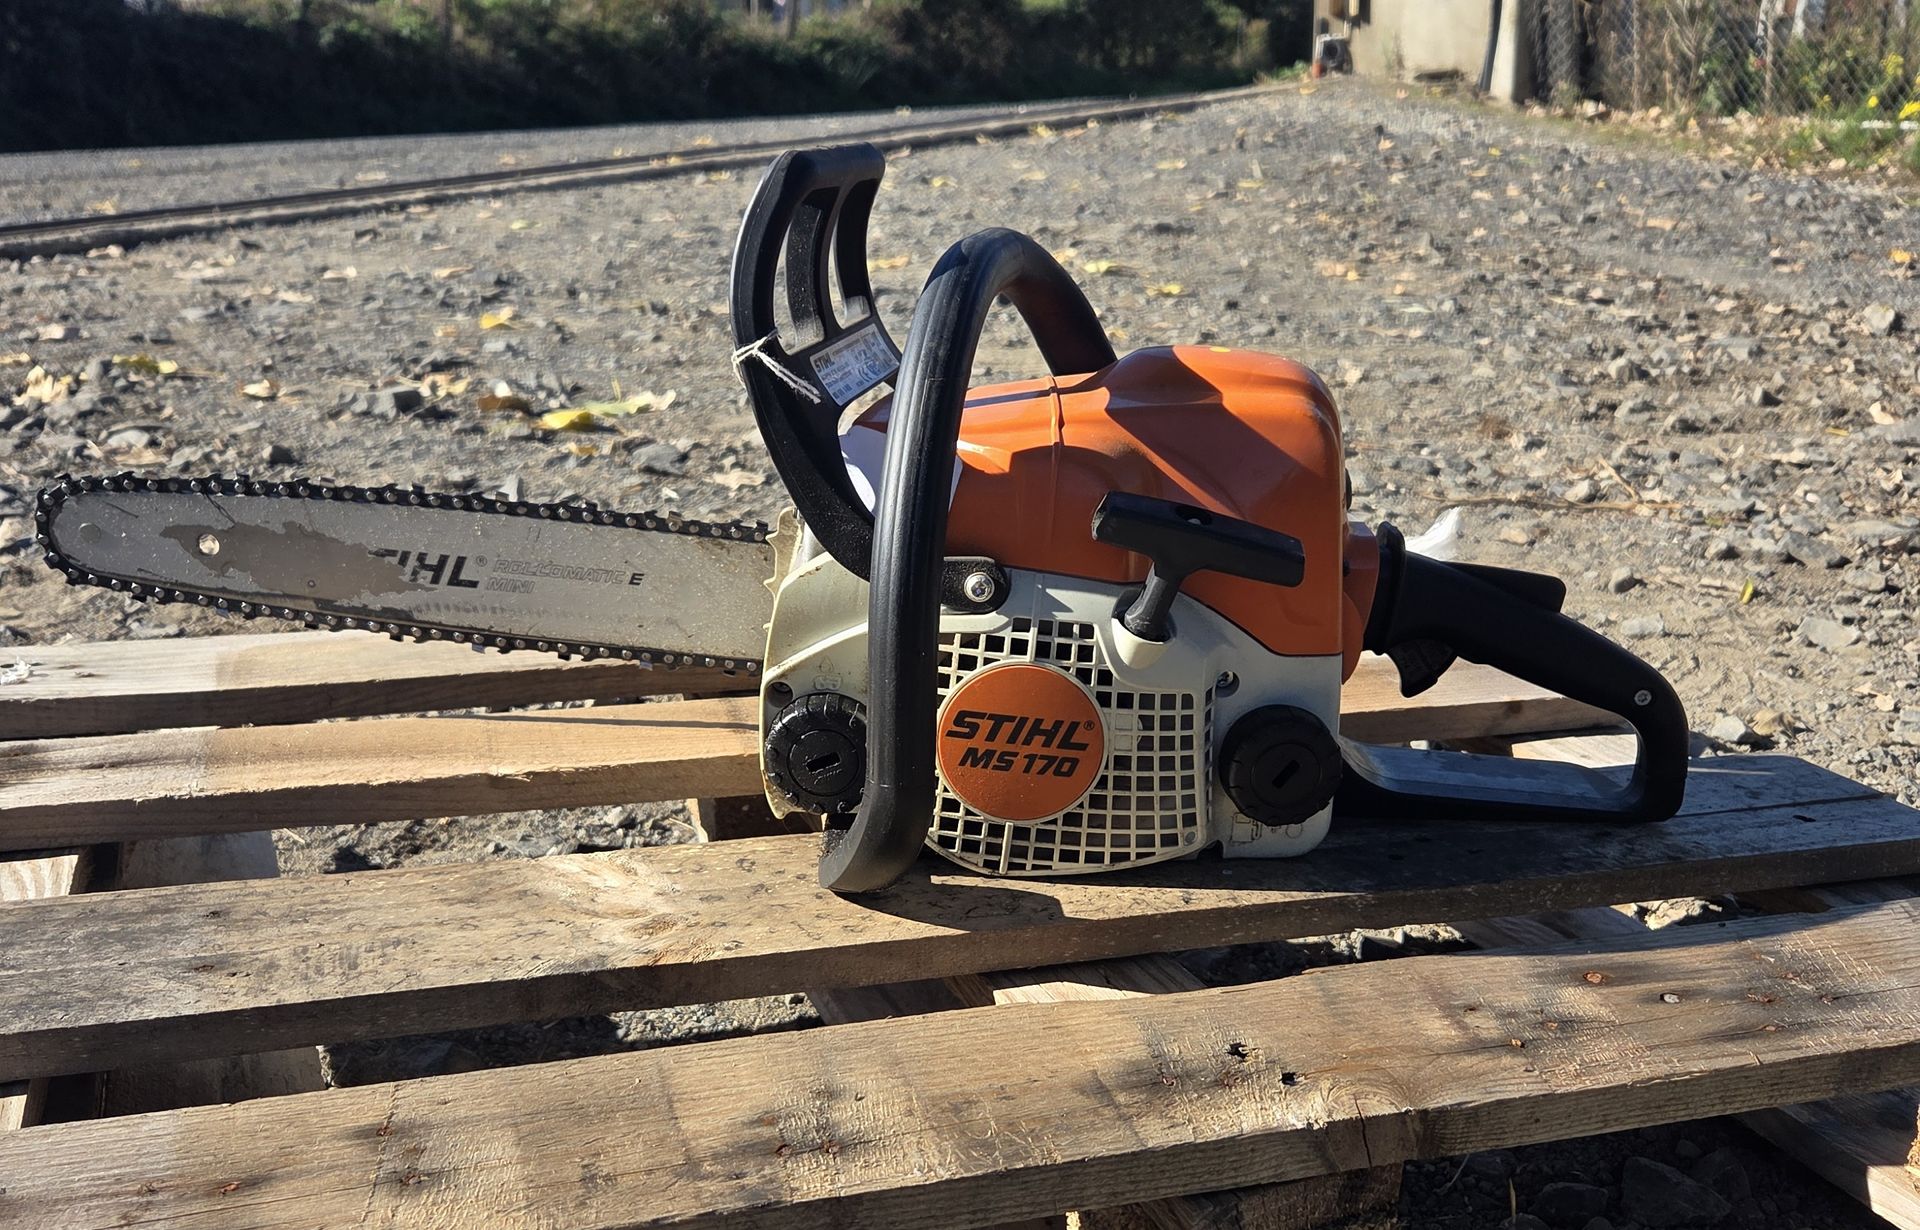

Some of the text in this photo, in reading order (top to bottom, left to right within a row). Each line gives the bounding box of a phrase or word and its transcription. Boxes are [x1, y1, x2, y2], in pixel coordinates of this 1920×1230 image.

[486, 577, 536, 594] MINI
[493, 559, 626, 585] ROLLOMATIC
[628, 572, 647, 586] E
[958, 747, 1080, 778] MS 170
